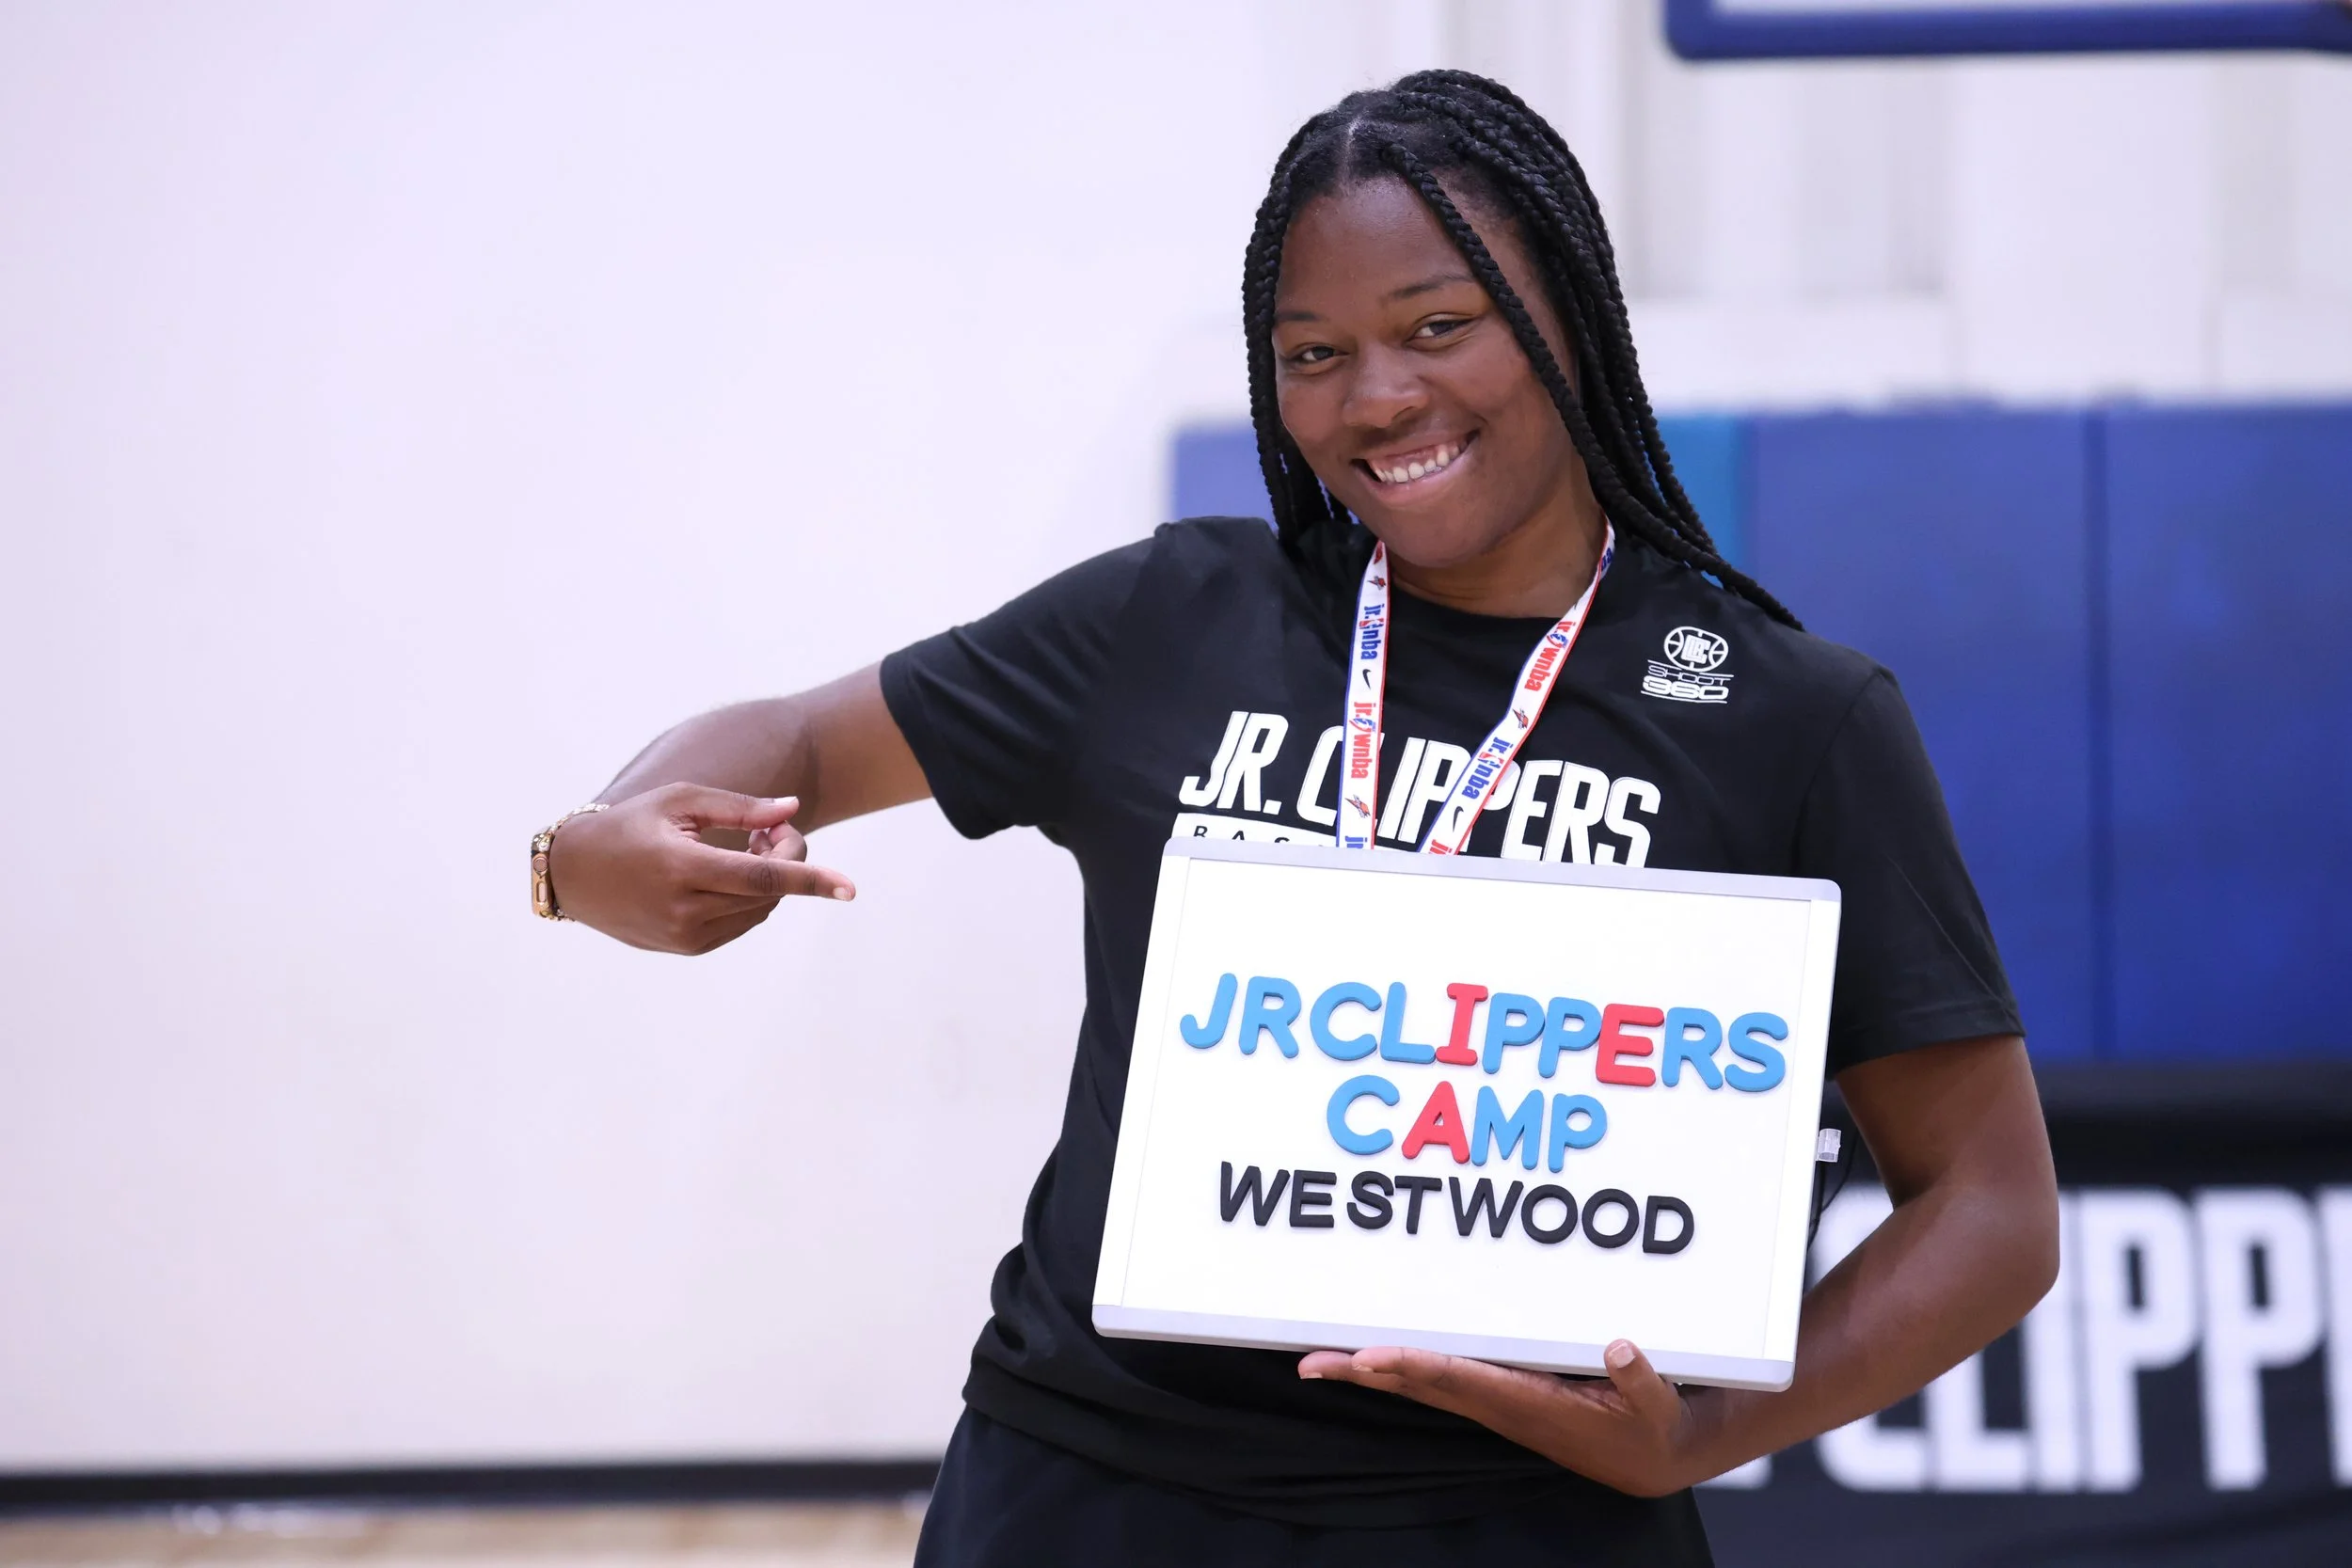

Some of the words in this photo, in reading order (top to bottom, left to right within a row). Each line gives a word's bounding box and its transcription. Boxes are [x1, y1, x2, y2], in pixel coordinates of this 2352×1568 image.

[1643, 675, 1729, 700] 360
[1647, 664, 1731, 686] SHOOT
[1178, 710, 1289, 816] JR.
[1326, 1073, 1609, 1173] CAMP
[1219, 1161, 1695, 1255] WESTWOOD
